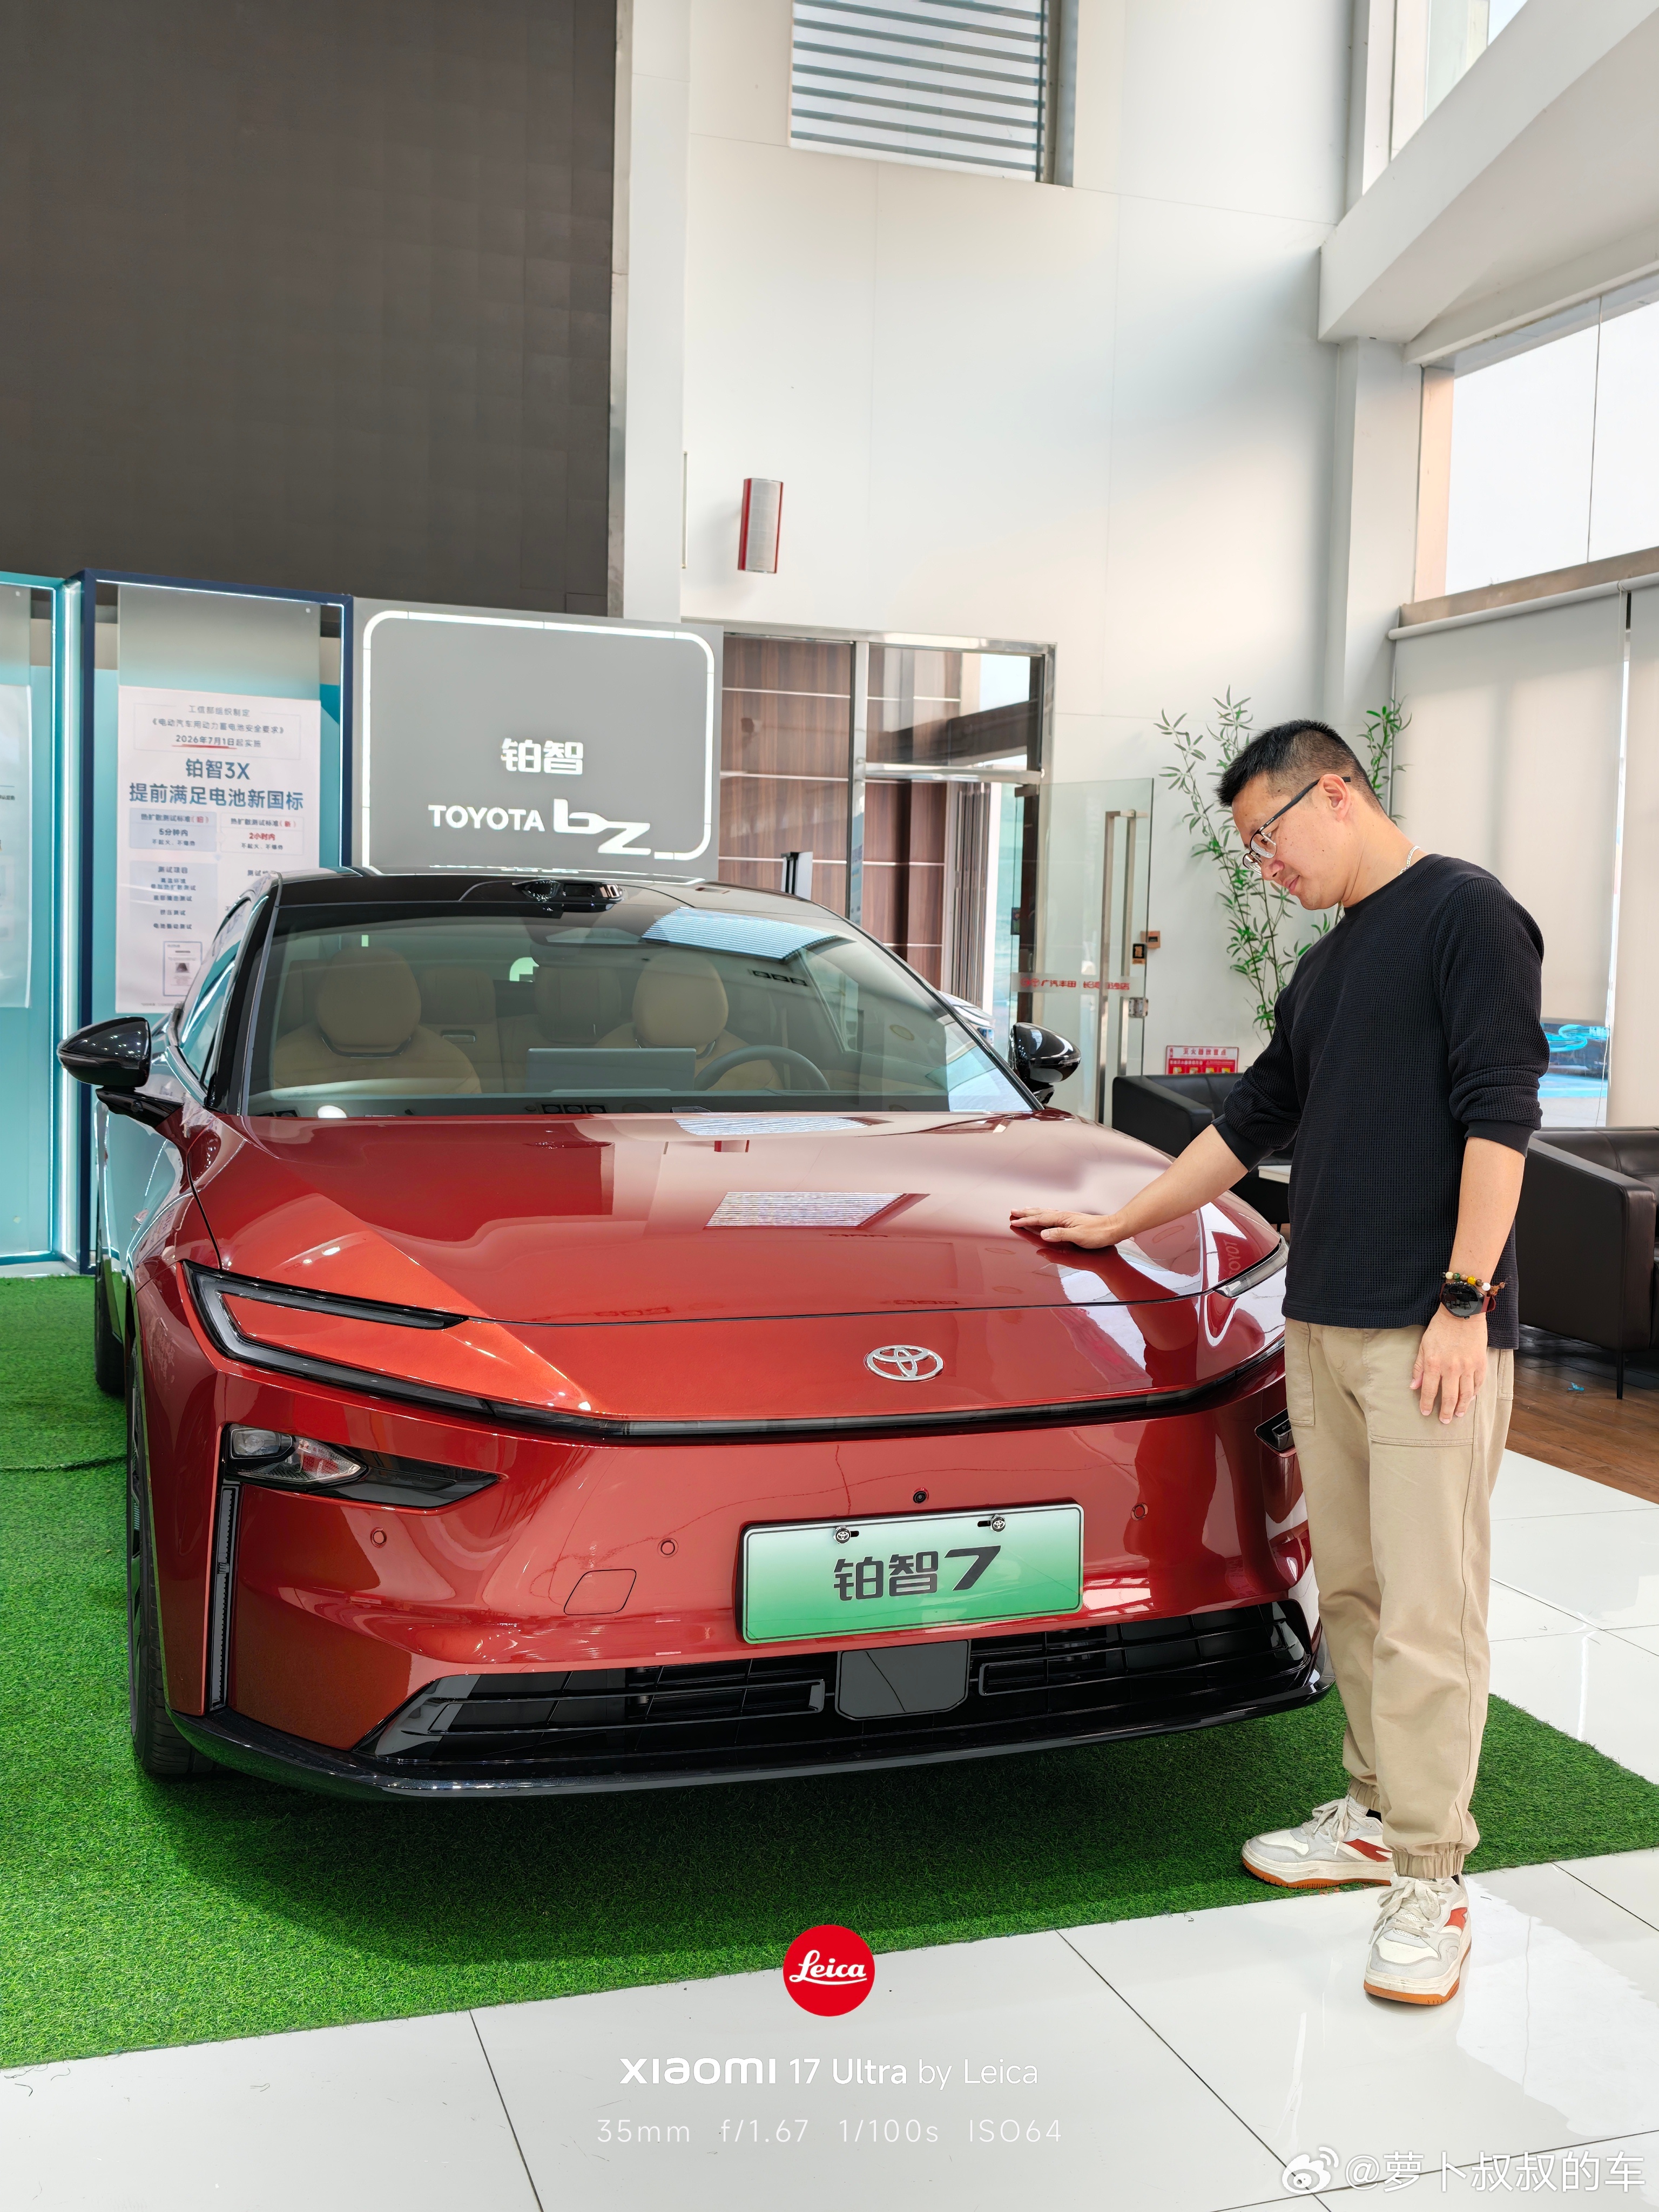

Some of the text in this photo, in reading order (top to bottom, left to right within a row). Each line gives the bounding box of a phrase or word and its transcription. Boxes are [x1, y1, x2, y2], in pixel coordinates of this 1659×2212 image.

[186, 758, 251, 780] 铂智3X
[501, 738, 583, 775] 铂智
[129, 783, 304, 811] 提前满足电池新国标
[428, 805, 545, 832] TOYOTA
